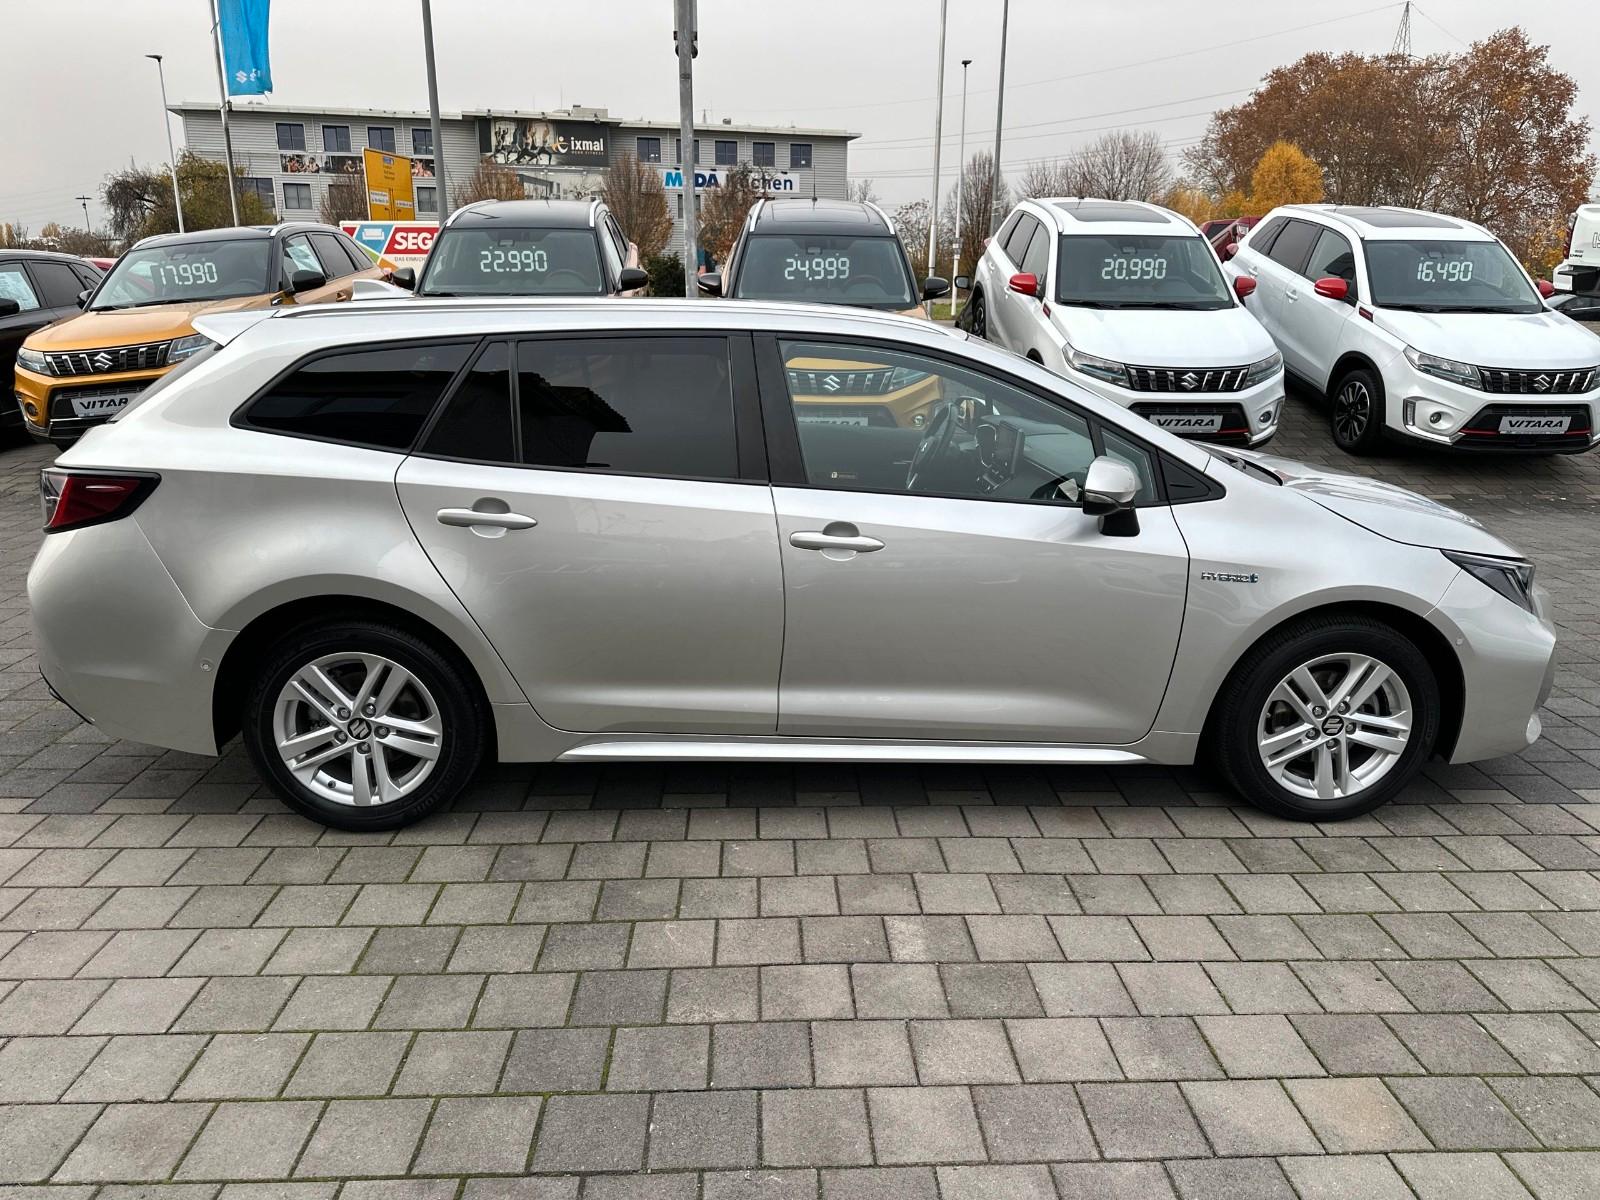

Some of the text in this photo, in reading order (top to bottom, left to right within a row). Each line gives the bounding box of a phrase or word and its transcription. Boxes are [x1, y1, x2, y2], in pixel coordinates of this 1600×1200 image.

[570, 137, 604, 152] ixmal
[664, 171, 719, 188] MDA
[394, 232, 438, 250] SEG
[480, 250, 548, 272] 22.990
[784, 257, 850, 281] 24.999
[1101, 258, 1167, 280] 20.990
[160, 262, 218, 285] 17.990
[1417, 261, 1473, 283] 16.490
[80, 397, 129, 410] VITAR
[1157, 418, 1215, 427] VITARA
[1508, 420, 1564, 428] VITARA
